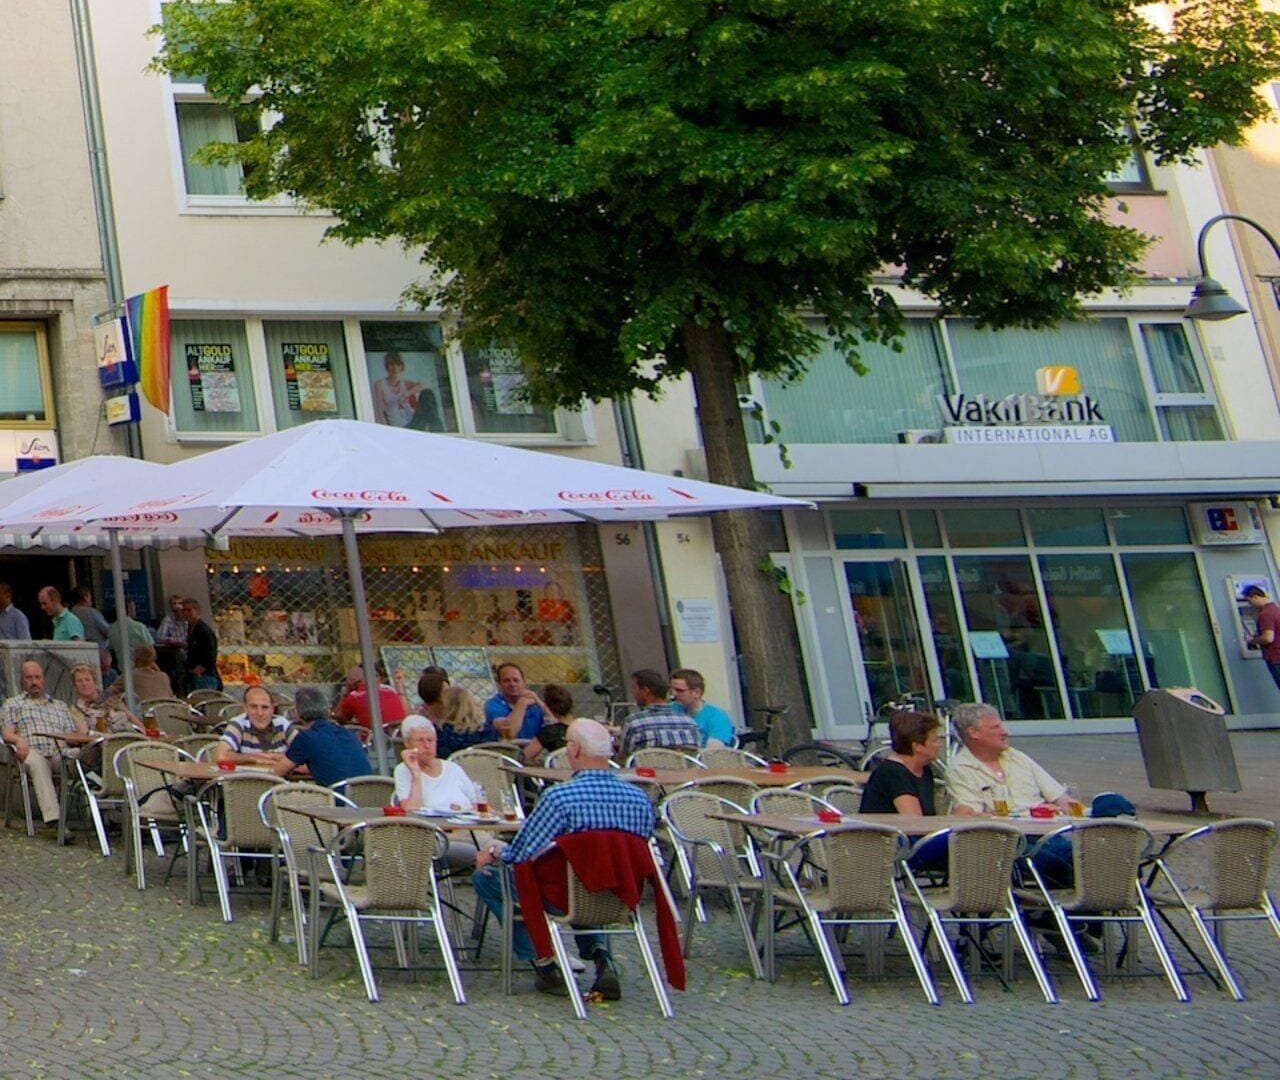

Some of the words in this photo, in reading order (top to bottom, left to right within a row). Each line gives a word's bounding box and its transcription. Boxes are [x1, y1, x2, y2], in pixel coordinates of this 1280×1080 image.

[957, 428, 1083, 442] INTERNATIONAL
[1088, 428, 1110, 441] AG
[615, 532, 631, 546] 56
